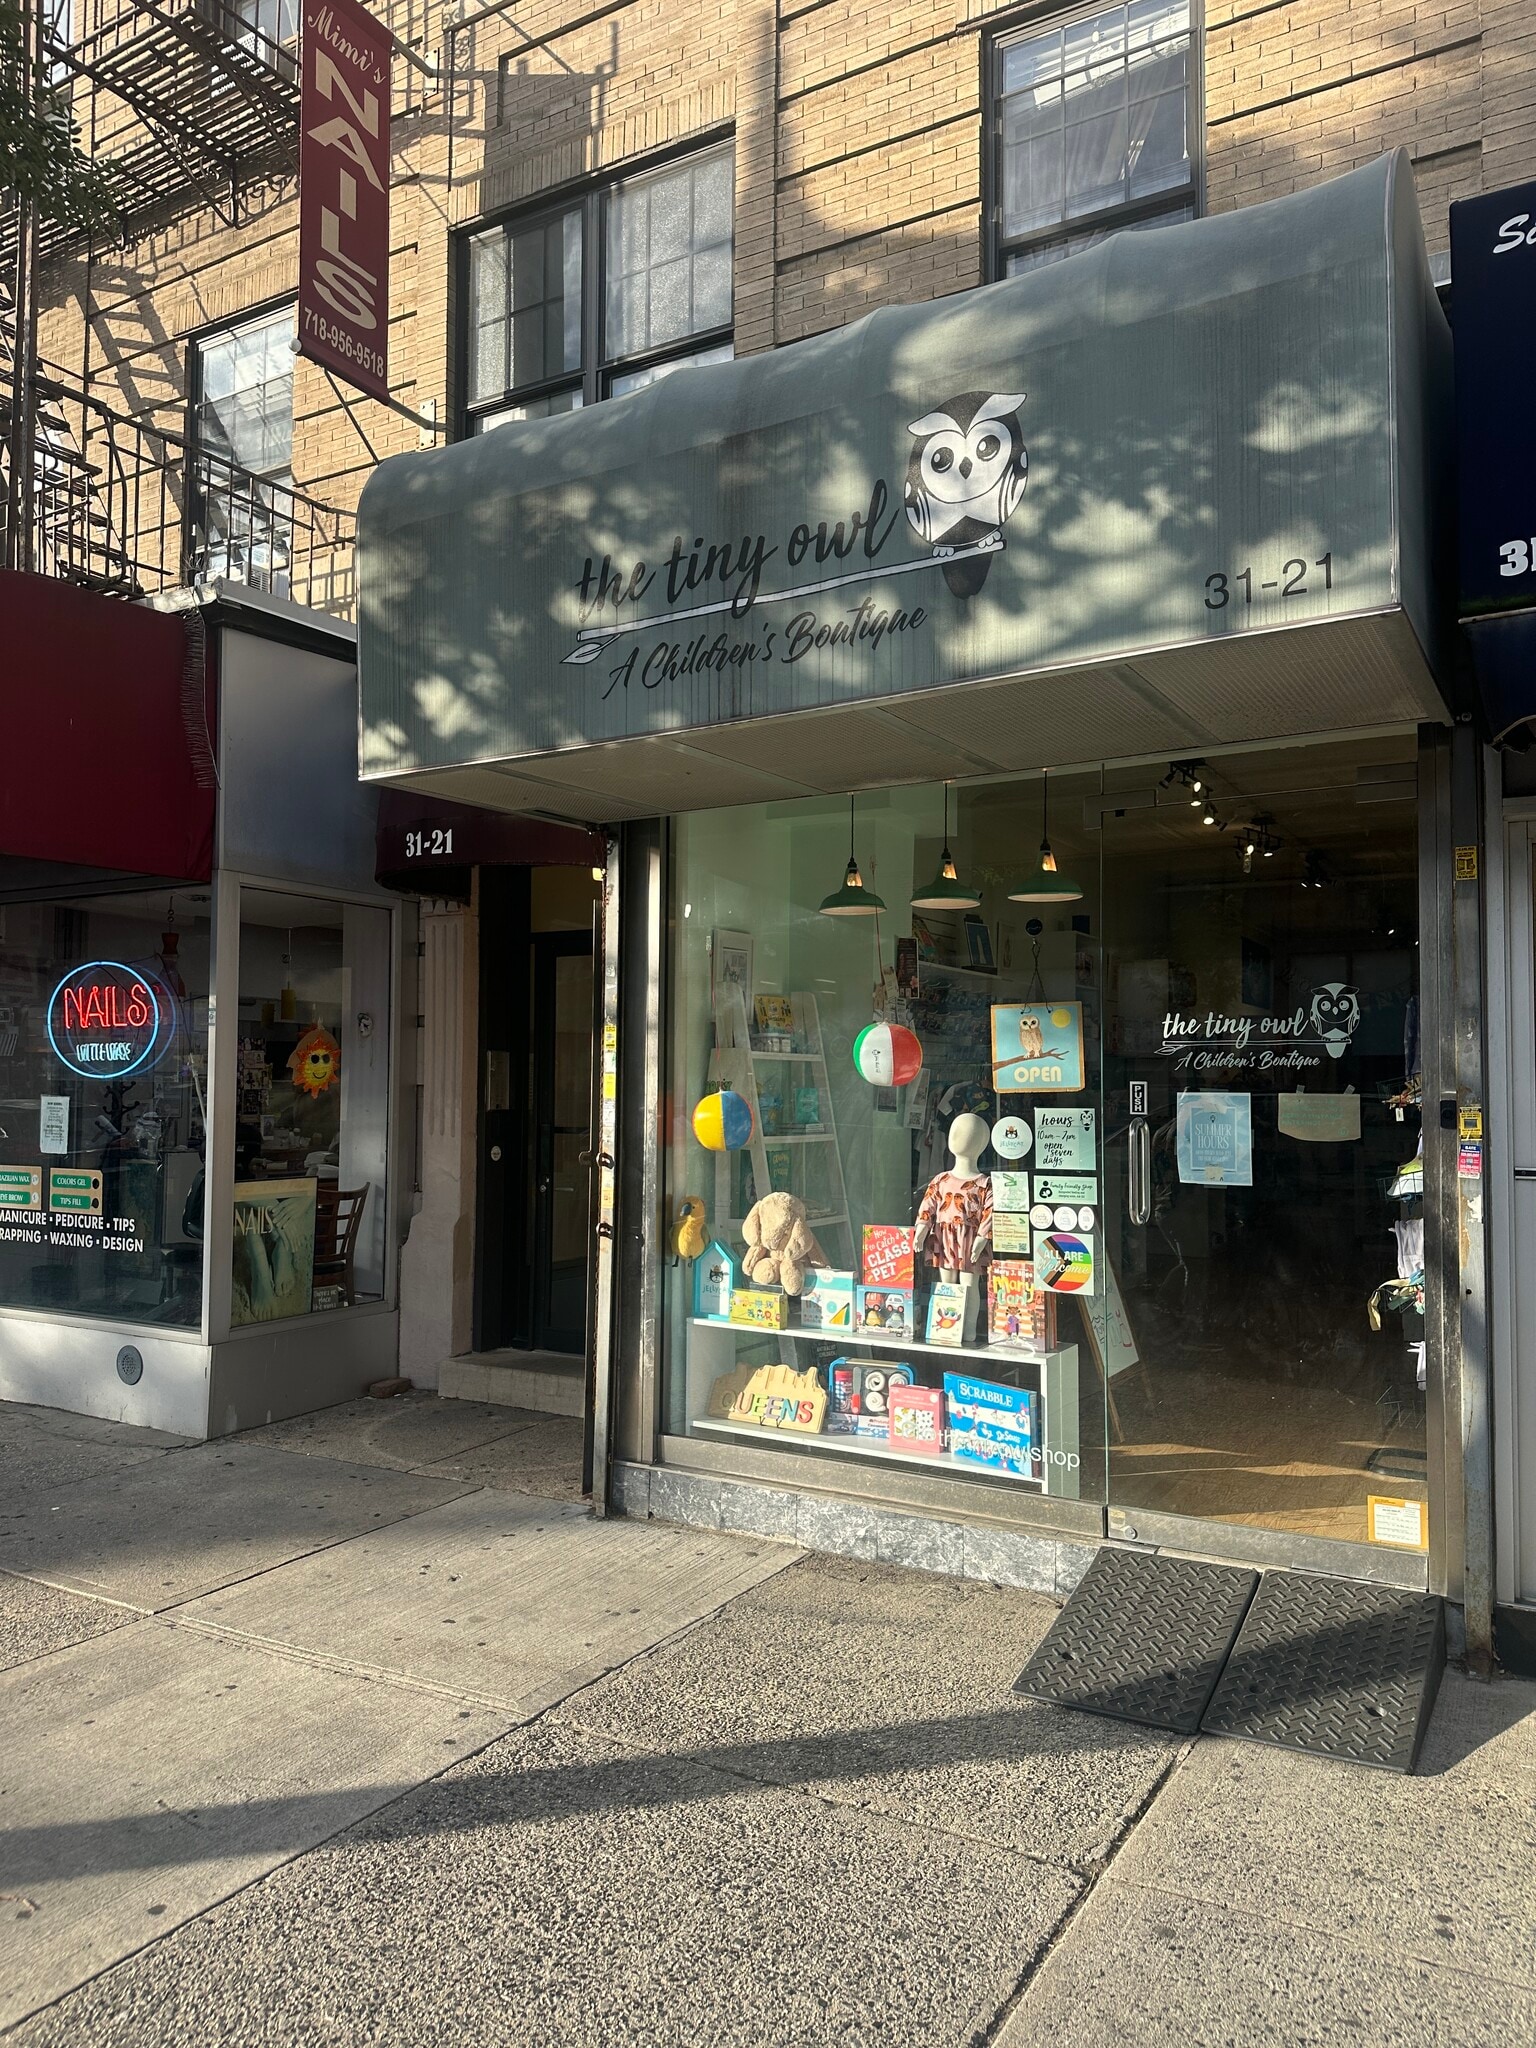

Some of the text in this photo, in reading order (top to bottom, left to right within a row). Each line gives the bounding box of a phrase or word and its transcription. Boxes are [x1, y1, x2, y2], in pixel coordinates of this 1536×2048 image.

[307, 5, 386, 84] Mimi's
[307, 47, 385, 330] NAILS
[304, 307, 384, 378] 718-956-9518
[575, 478, 900, 624] the tiny owl
[1204, 552, 1332, 610] 31-21
[602, 596, 928, 700] A Children's Boutique
[406, 829, 453, 858] 31-21
[64, 983, 148, 1029] NAILS
[1162, 1007, 1309, 1049] the tiny owl
[1174, 1049, 1320, 1070] A Children's Boutique
[1014, 1065, 1062, 1083] OPEN
[1134, 1085, 1142, 1111] PUSH
[1195, 1123, 1232, 1136] SUMMER
[1044, 1142, 1063, 1152] open
[1050, 1149, 1074, 1158] seven
[1198, 1136, 1229, 1149] HOURS
[1042, 1155, 1064, 1168] days
[57, 1177, 76, 1186] COLORS
[60, 1197, 71, 1205] TIPS
[55, 1213, 104, 1230] PEDICURE
[113, 1217, 136, 1233] TIPS
[234, 1206, 274, 1236] NAILS
[50, 1231, 93, 1248] WAXING
[102, 1236, 144, 1253] DESIGN
[873, 1229, 887, 1239] How
[867, 1240, 911, 1268] CLASS
[1044, 1250, 1084, 1262] ALL ARE
[871, 1261, 896, 1282] PET
[993, 1275, 1035, 1303] Mary
[721, 1391, 814, 1423] QUEENS
[960, 1383, 1014, 1407] SCRABBLE
